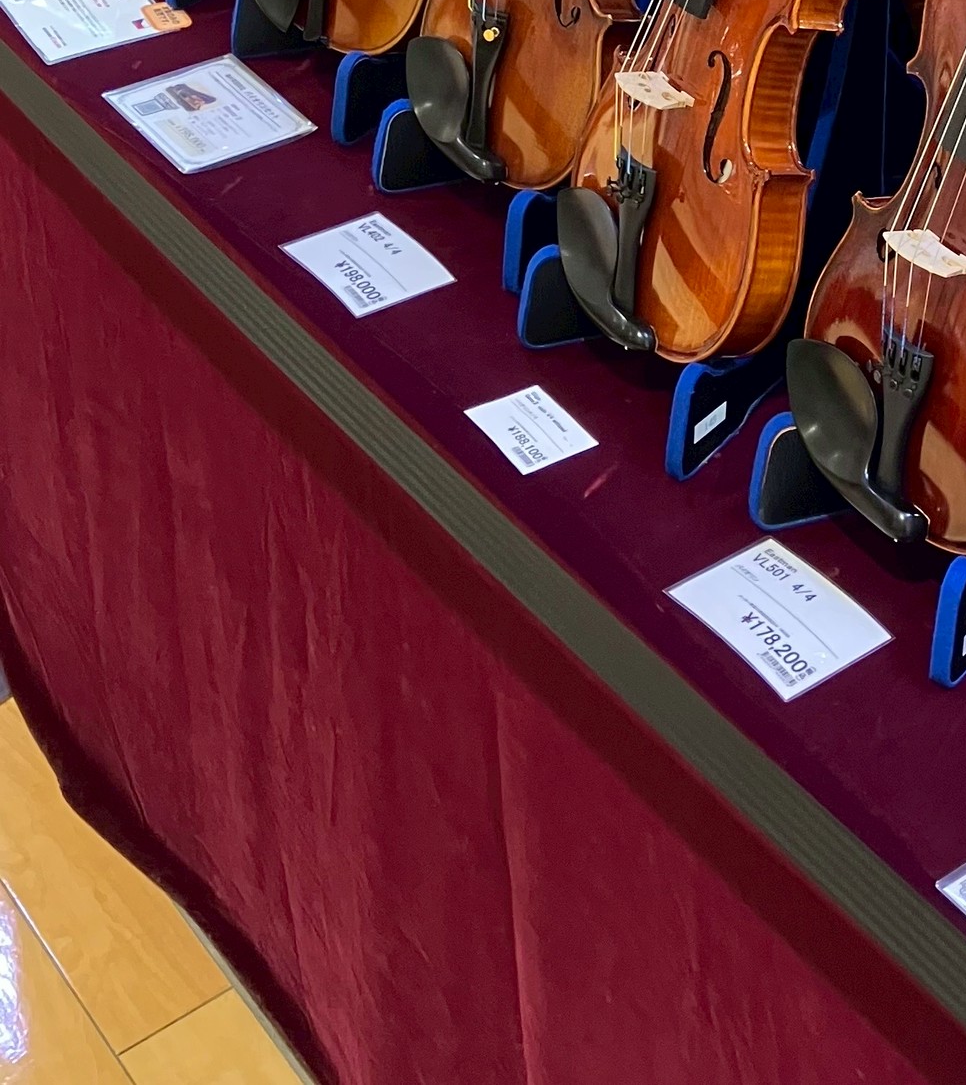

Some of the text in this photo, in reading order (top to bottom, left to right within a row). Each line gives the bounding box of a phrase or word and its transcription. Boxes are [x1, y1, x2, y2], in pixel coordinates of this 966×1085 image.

[357, 222, 386, 243] VL402
[383, 242, 402, 255] 4/4
[334, 260, 382, 301] ¥198,000
[507, 425, 544, 460] ¥188,100
[752, 552, 818, 602] VL501 4/4
[763, 547, 798, 574] Eastman
[740, 611, 808, 673] ¥178,200
